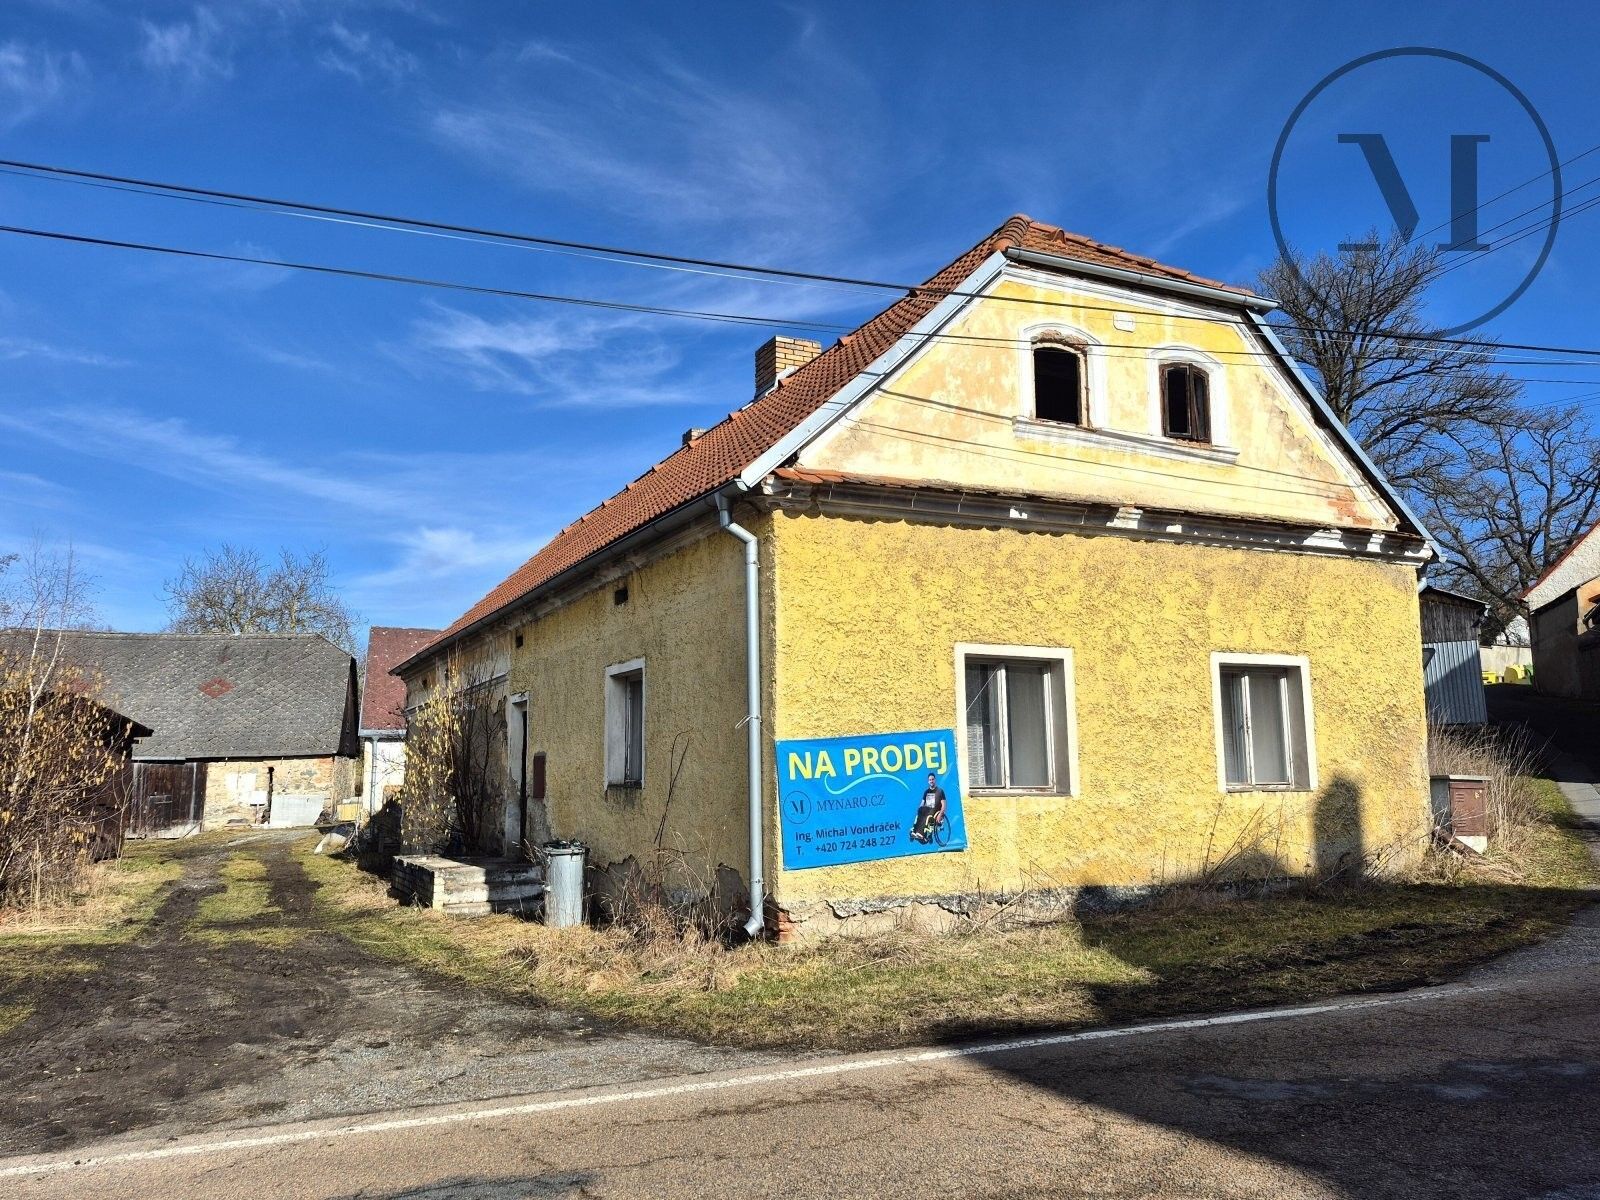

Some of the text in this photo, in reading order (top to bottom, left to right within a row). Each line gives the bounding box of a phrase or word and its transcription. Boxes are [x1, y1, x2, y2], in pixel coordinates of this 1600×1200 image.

[788, 741, 948, 780] NA PRODEJ
[791, 799, 805, 816] M
[816, 794, 886, 812] MYNARO.CZ
[795, 820, 901, 843] Ing. Michal Vondráček
[796, 835, 896, 856] T. +420 724 248 227
